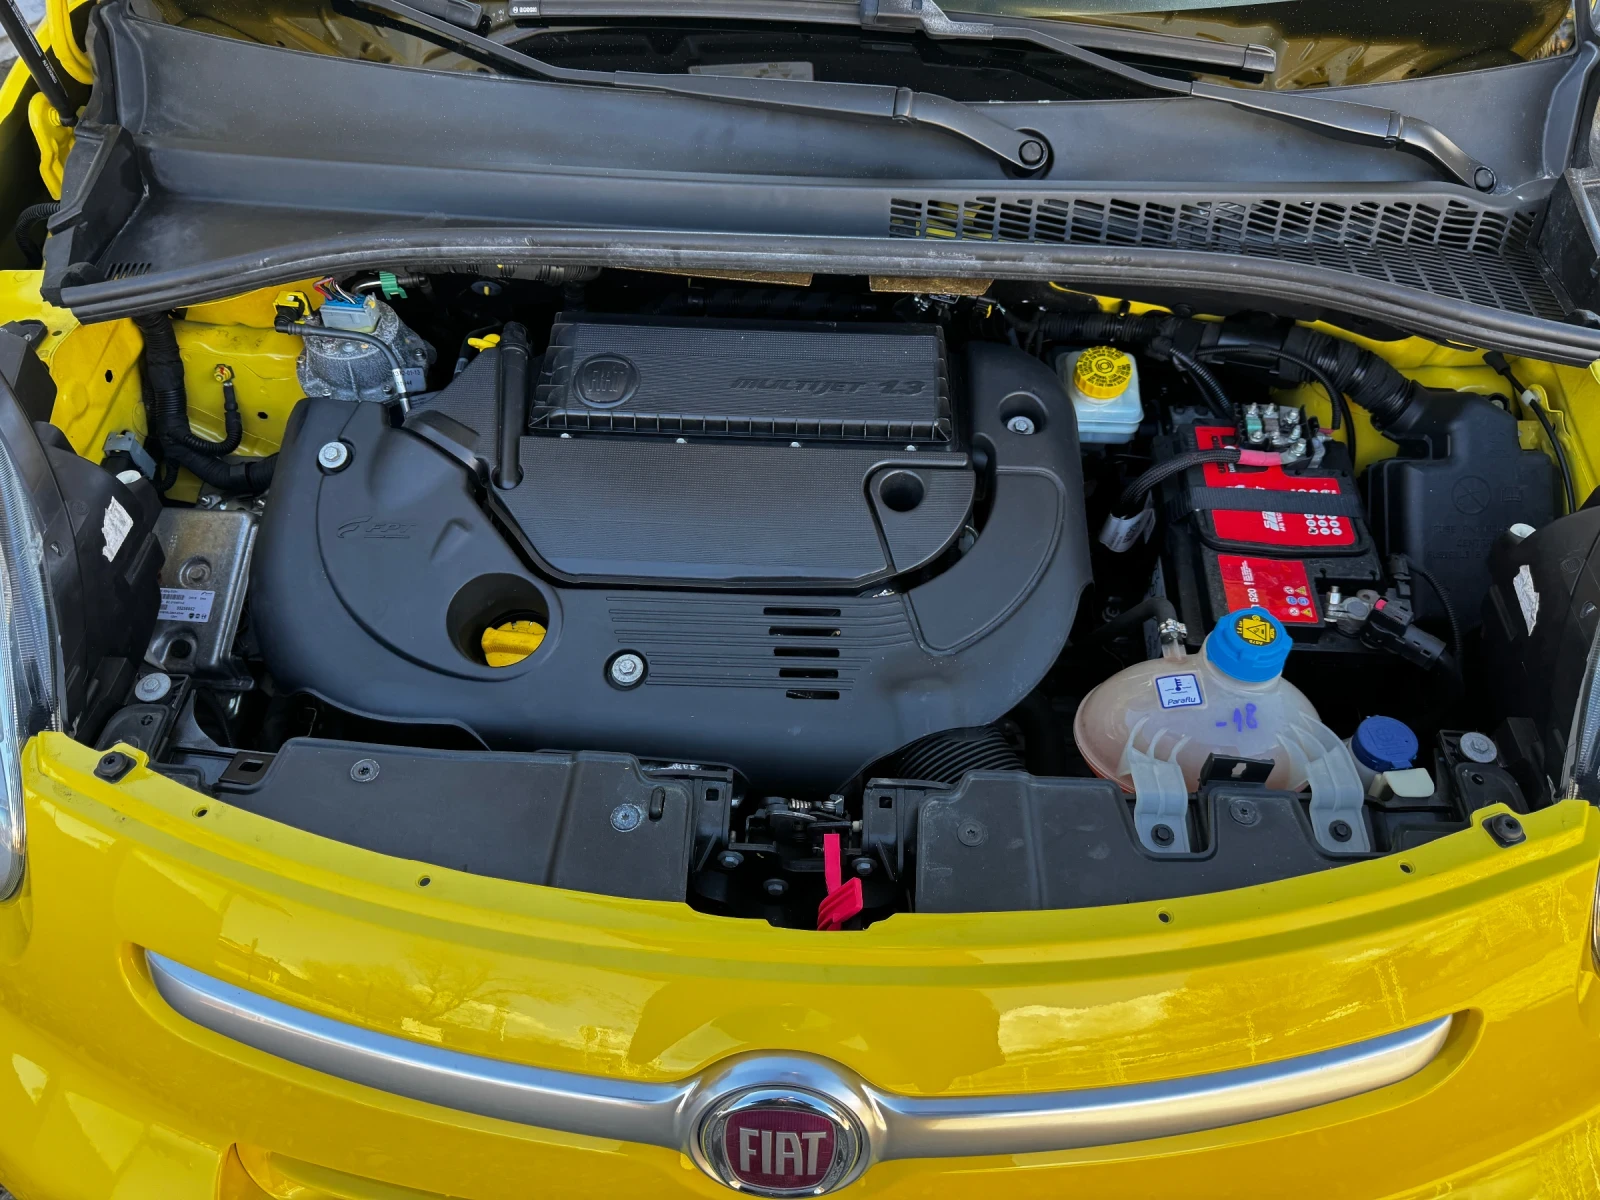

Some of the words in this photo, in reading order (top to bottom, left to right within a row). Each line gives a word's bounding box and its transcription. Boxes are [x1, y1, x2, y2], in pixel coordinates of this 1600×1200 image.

[586, 370, 625, 393] FIAT
[1247, 588, 1258, 604] 520
[1167, 696, 1196, 706] Paraflu
[739, 1127, 828, 1177] FIAT
